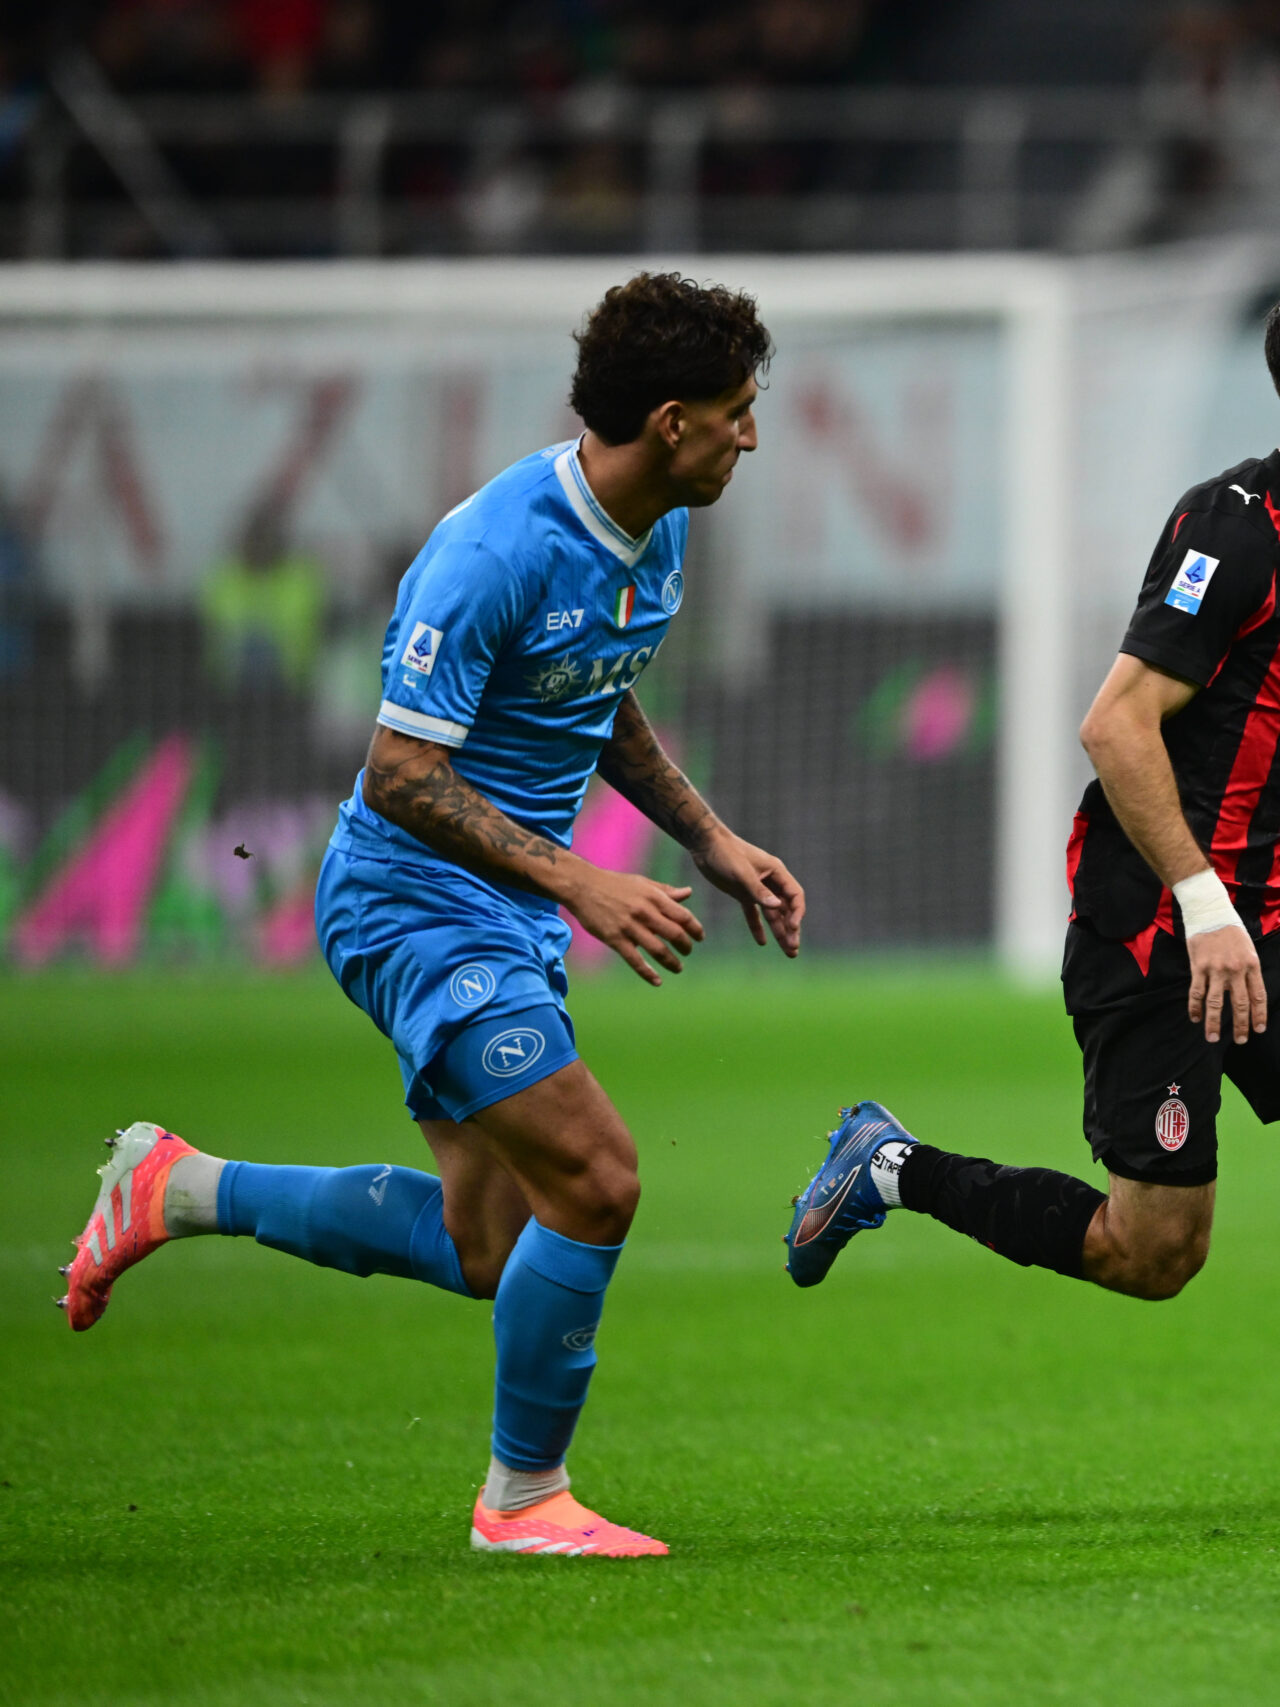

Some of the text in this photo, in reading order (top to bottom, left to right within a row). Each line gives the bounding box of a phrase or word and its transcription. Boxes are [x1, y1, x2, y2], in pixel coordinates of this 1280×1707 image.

[547, 609, 585, 630] EA7
[580, 637, 666, 696] MS
[1165, 1102, 1182, 1111] ACM
